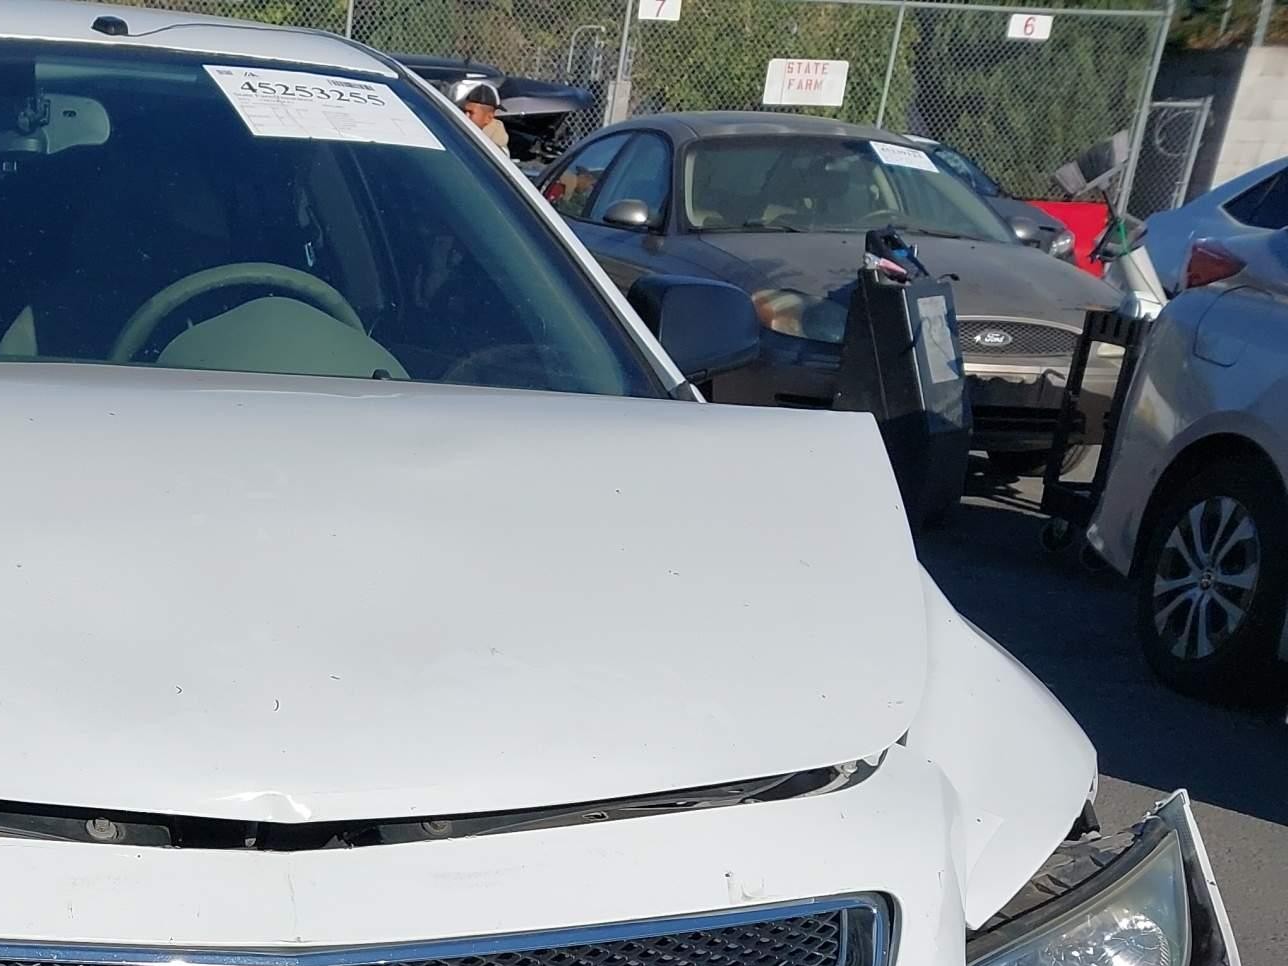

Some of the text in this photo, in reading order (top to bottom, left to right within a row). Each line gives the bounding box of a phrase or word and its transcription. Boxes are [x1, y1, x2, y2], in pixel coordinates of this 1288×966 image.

[655, 0, 667, 17] 7
[1023, 16, 1036, 36] 6
[786, 62, 830, 75] STATE
[240, 81, 386, 106] 45253255
[787, 79, 824, 91] FARM
